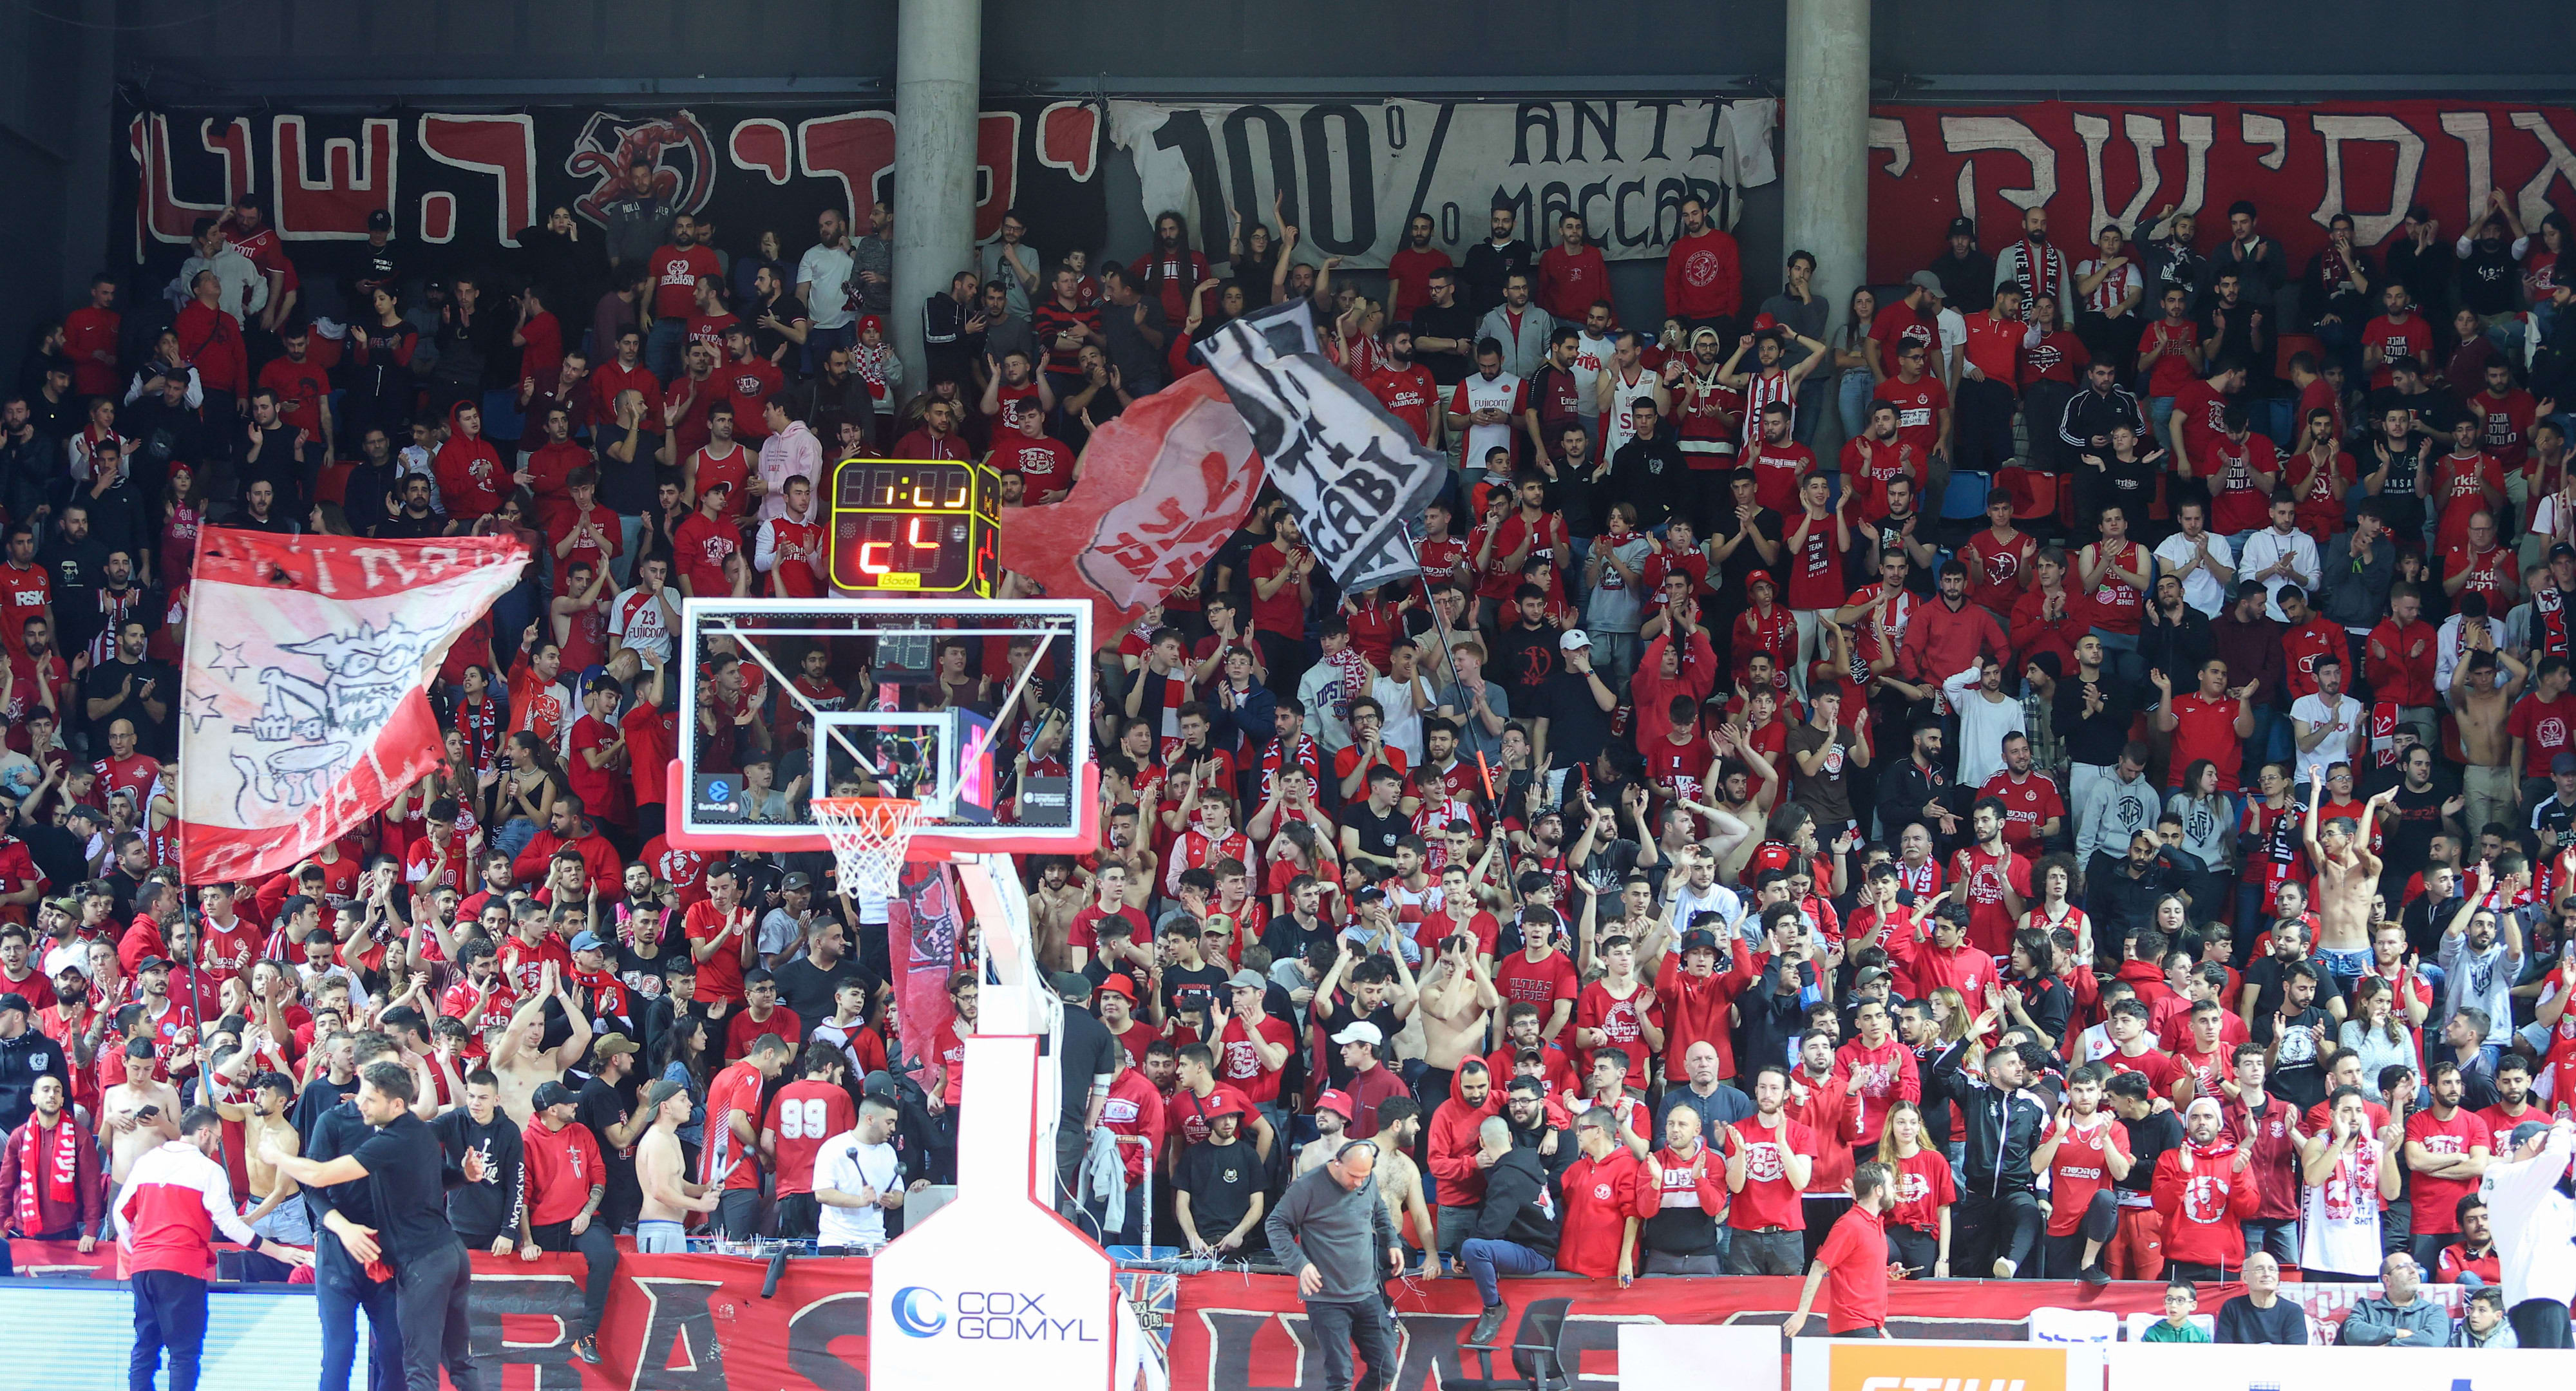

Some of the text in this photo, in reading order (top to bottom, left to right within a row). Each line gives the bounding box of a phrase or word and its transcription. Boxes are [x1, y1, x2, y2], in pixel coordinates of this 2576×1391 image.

[1509, 99, 1734, 166] ANTI
[1869, 111, 2576, 247] אוסישקי
[2014, 240, 2032, 321] HATE RACISM
[1388, 398, 1425, 409] Huancayo
[179, 509, 193, 522] 41
[1808, 534, 1821, 542] ONE
[1808, 542, 1824, 552] TEAM
[1808, 552, 1820, 562] ONE
[1808, 560, 1828, 572] DREAM
[14, 590, 45, 607] RSK
[641, 610, 656, 627] 23
[156, 835, 166, 866] HAPO
[1509, 978, 1553, 990] ULTRAS
[1510, 989, 1549, 1001] HAPOEL
[478, 1011, 509, 1029] rkia
[779, 1097, 827, 1140] 99
[2060, 1165, 2091, 1175] הכשרה
[508, 1160, 526, 1229] AIR JORDAN
[958, 1291, 1046, 1316] COX
[957, 1316, 1099, 1342] GOMYL
